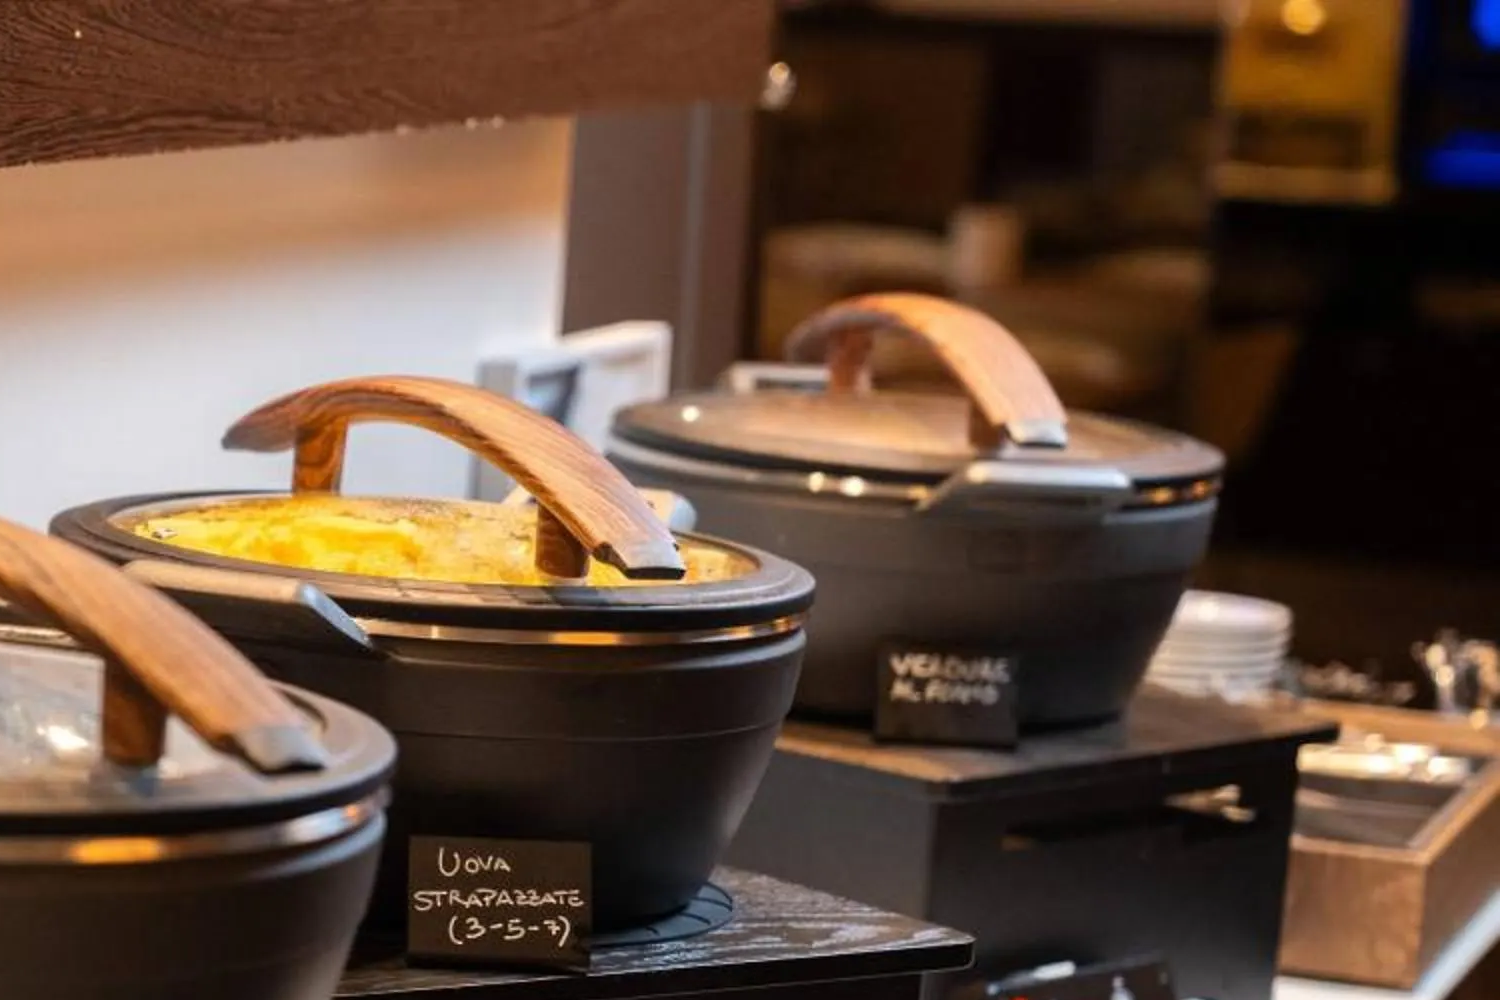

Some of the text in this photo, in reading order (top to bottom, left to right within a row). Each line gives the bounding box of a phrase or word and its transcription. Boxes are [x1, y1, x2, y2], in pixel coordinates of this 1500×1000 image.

[438, 847, 511, 877] UOVA
[413, 887, 585, 911] STRAPAZZATE
[448, 915, 571, 947] (3-5-7)
